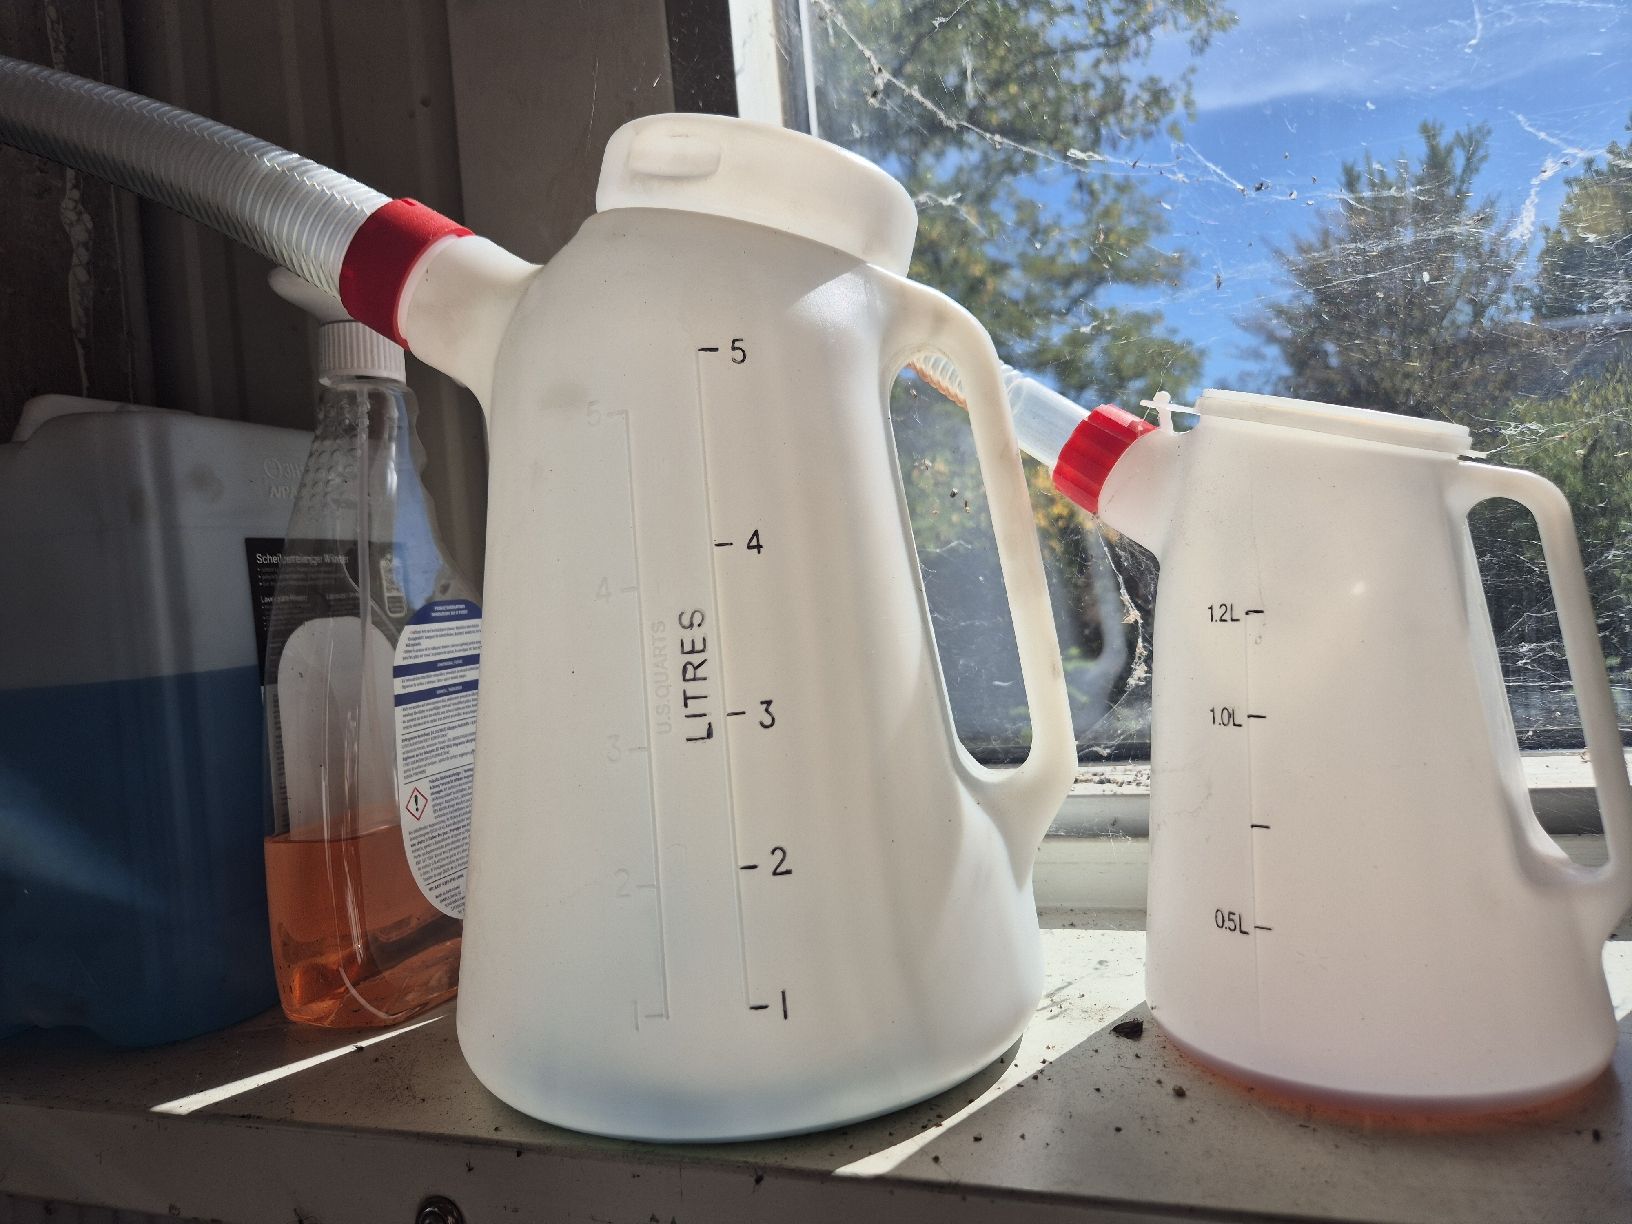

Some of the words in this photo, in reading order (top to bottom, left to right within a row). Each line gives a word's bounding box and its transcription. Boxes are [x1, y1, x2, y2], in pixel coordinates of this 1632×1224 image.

[730, 338, 747, 364] 5
[586, 400, 601, 427] 5
[746, 529, 763, 555] 4
[596, 576, 612, 604] 4
[1207, 603, 1241, 622] 1.2L
[678, 609, 714, 743] LITRES
[759, 699, 776, 729] 3
[1209, 706, 1243, 727] 1.0L
[770, 846, 793, 877] 2
[613, 867, 631, 898] 2
[1214, 908, 1250, 935] 0.5L
[780, 988, 788, 1021] 1
